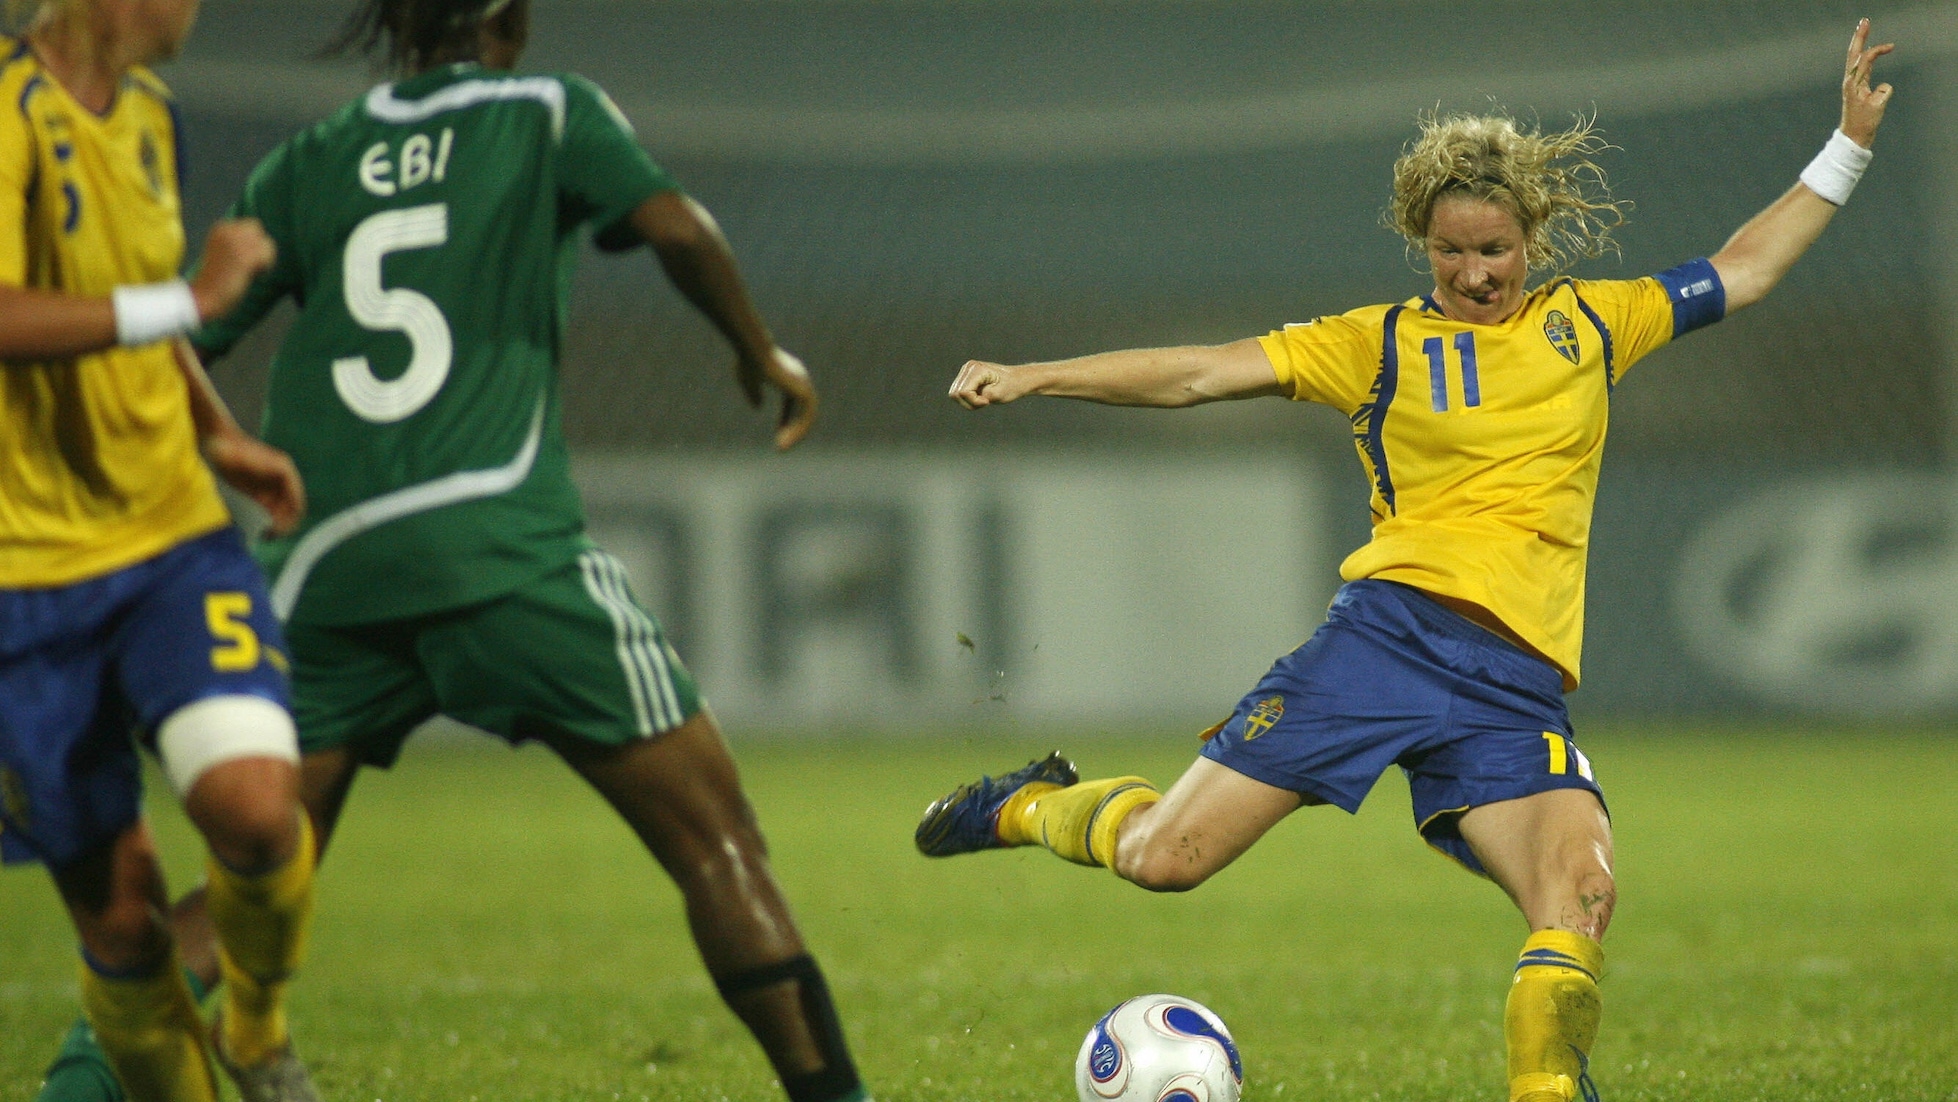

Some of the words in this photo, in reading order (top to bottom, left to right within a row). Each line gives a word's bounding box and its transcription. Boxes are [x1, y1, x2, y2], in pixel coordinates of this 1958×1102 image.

[359, 127, 454, 196] EBI
[331, 201, 453, 424] 5
[1422, 330, 1482, 414] 11
[204, 591, 261, 673] 5
